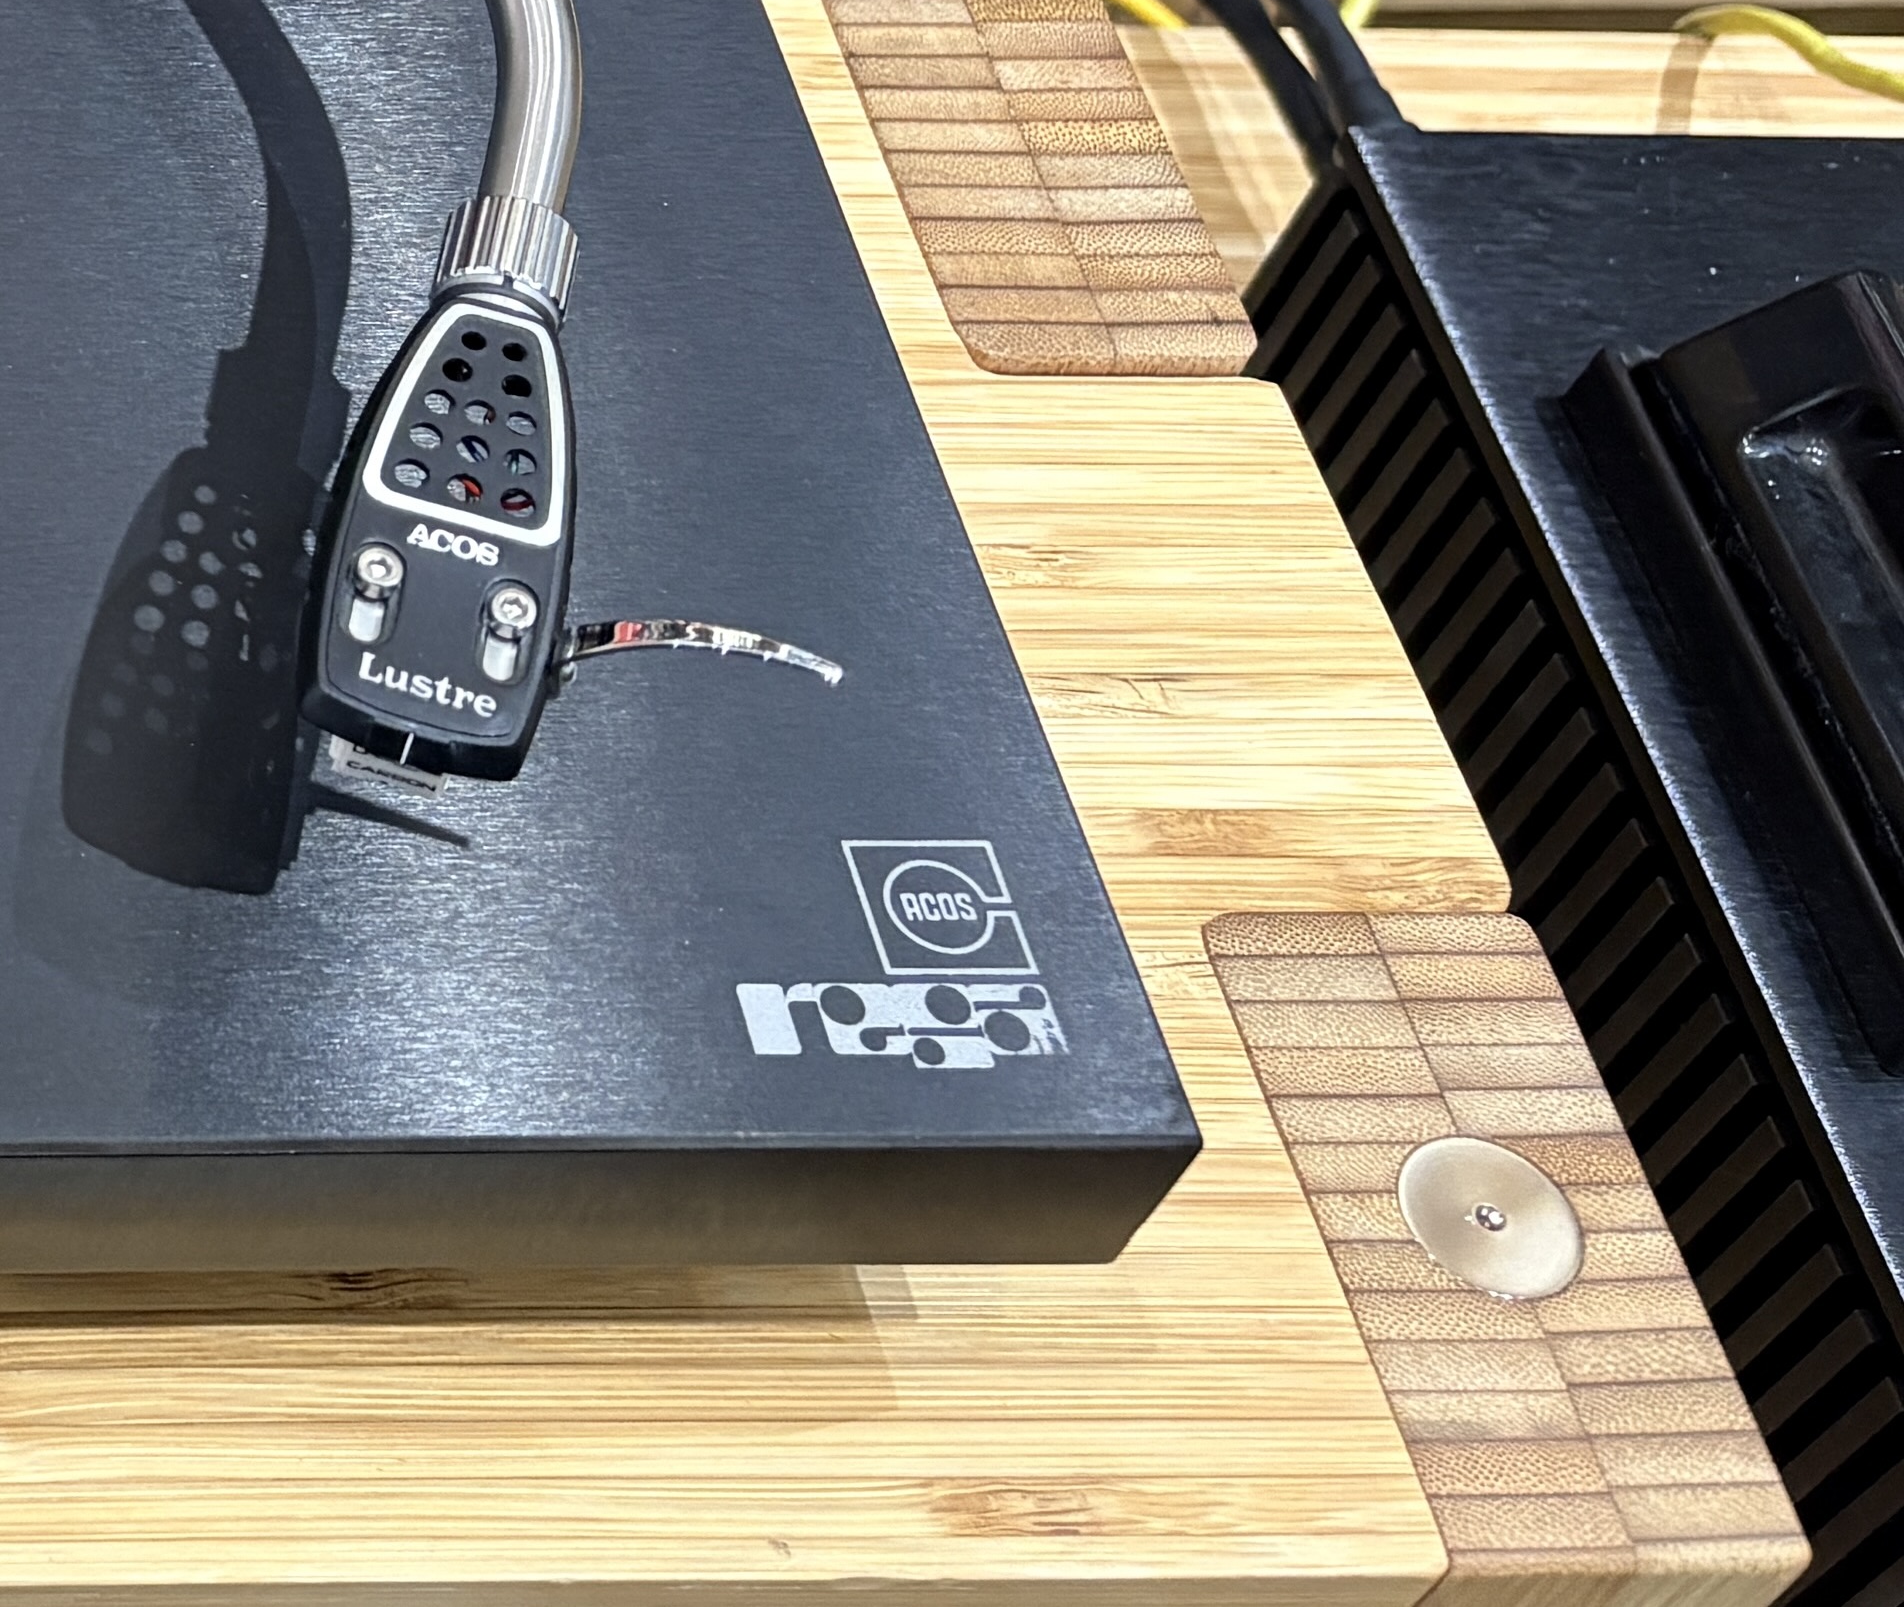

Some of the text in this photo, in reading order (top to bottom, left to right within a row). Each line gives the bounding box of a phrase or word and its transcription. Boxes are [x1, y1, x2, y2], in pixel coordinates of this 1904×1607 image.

[406, 523, 500, 566] ACOS
[358, 651, 497, 718] Lustre
[899, 892, 978, 921] ACOS
